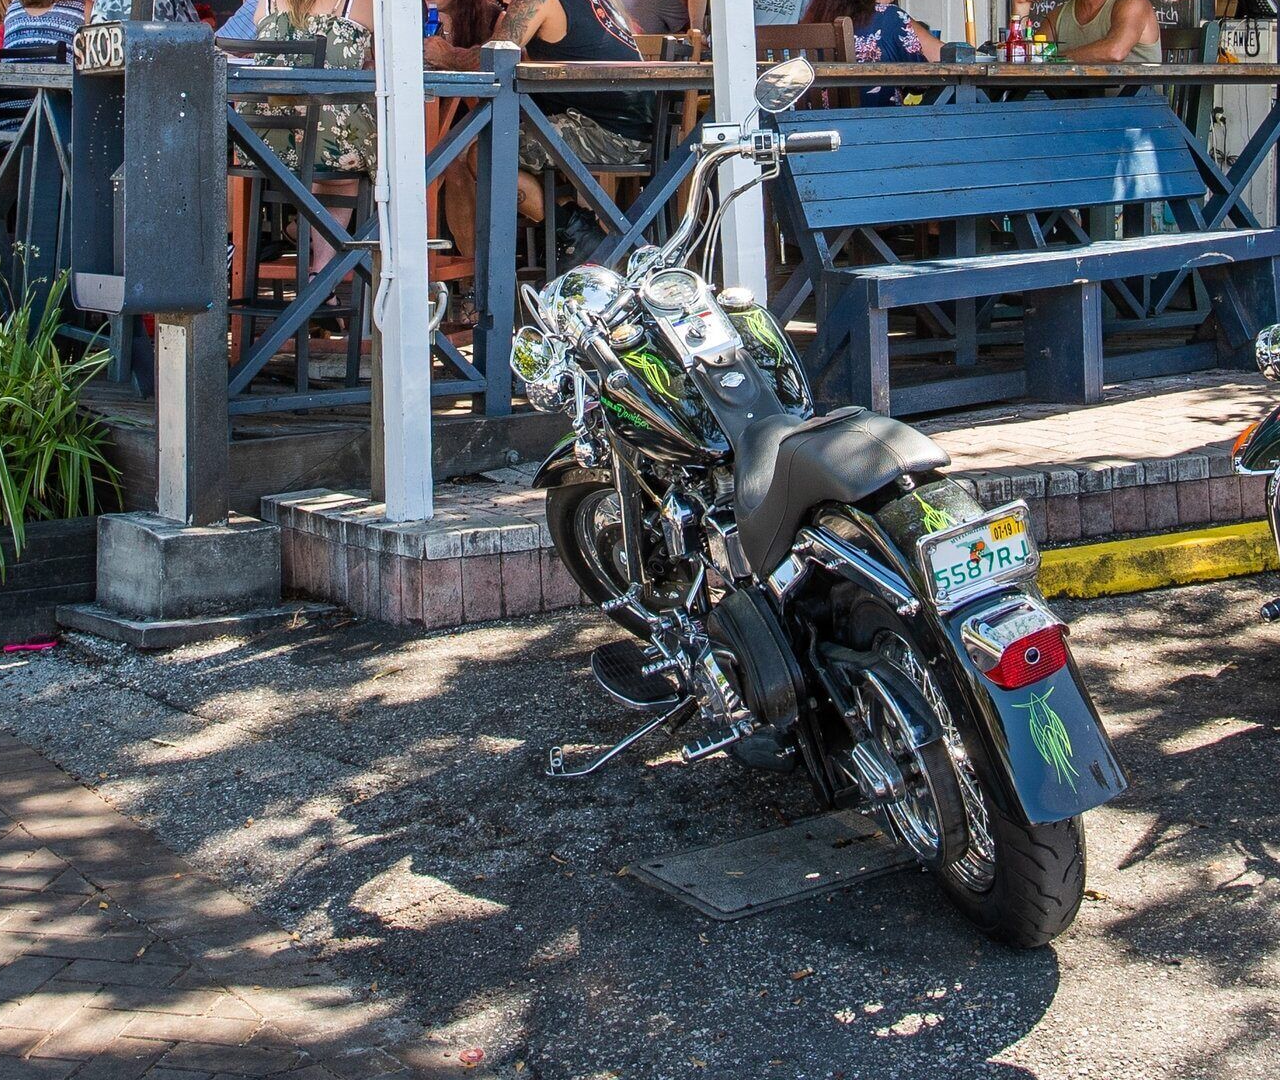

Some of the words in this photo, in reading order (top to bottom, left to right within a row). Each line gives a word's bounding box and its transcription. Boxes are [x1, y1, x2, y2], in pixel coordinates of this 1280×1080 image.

[73, 28, 124, 70] SKOB
[993, 522, 1013, 540] 07-19
[935, 540, 1029, 590] 5587RJ
